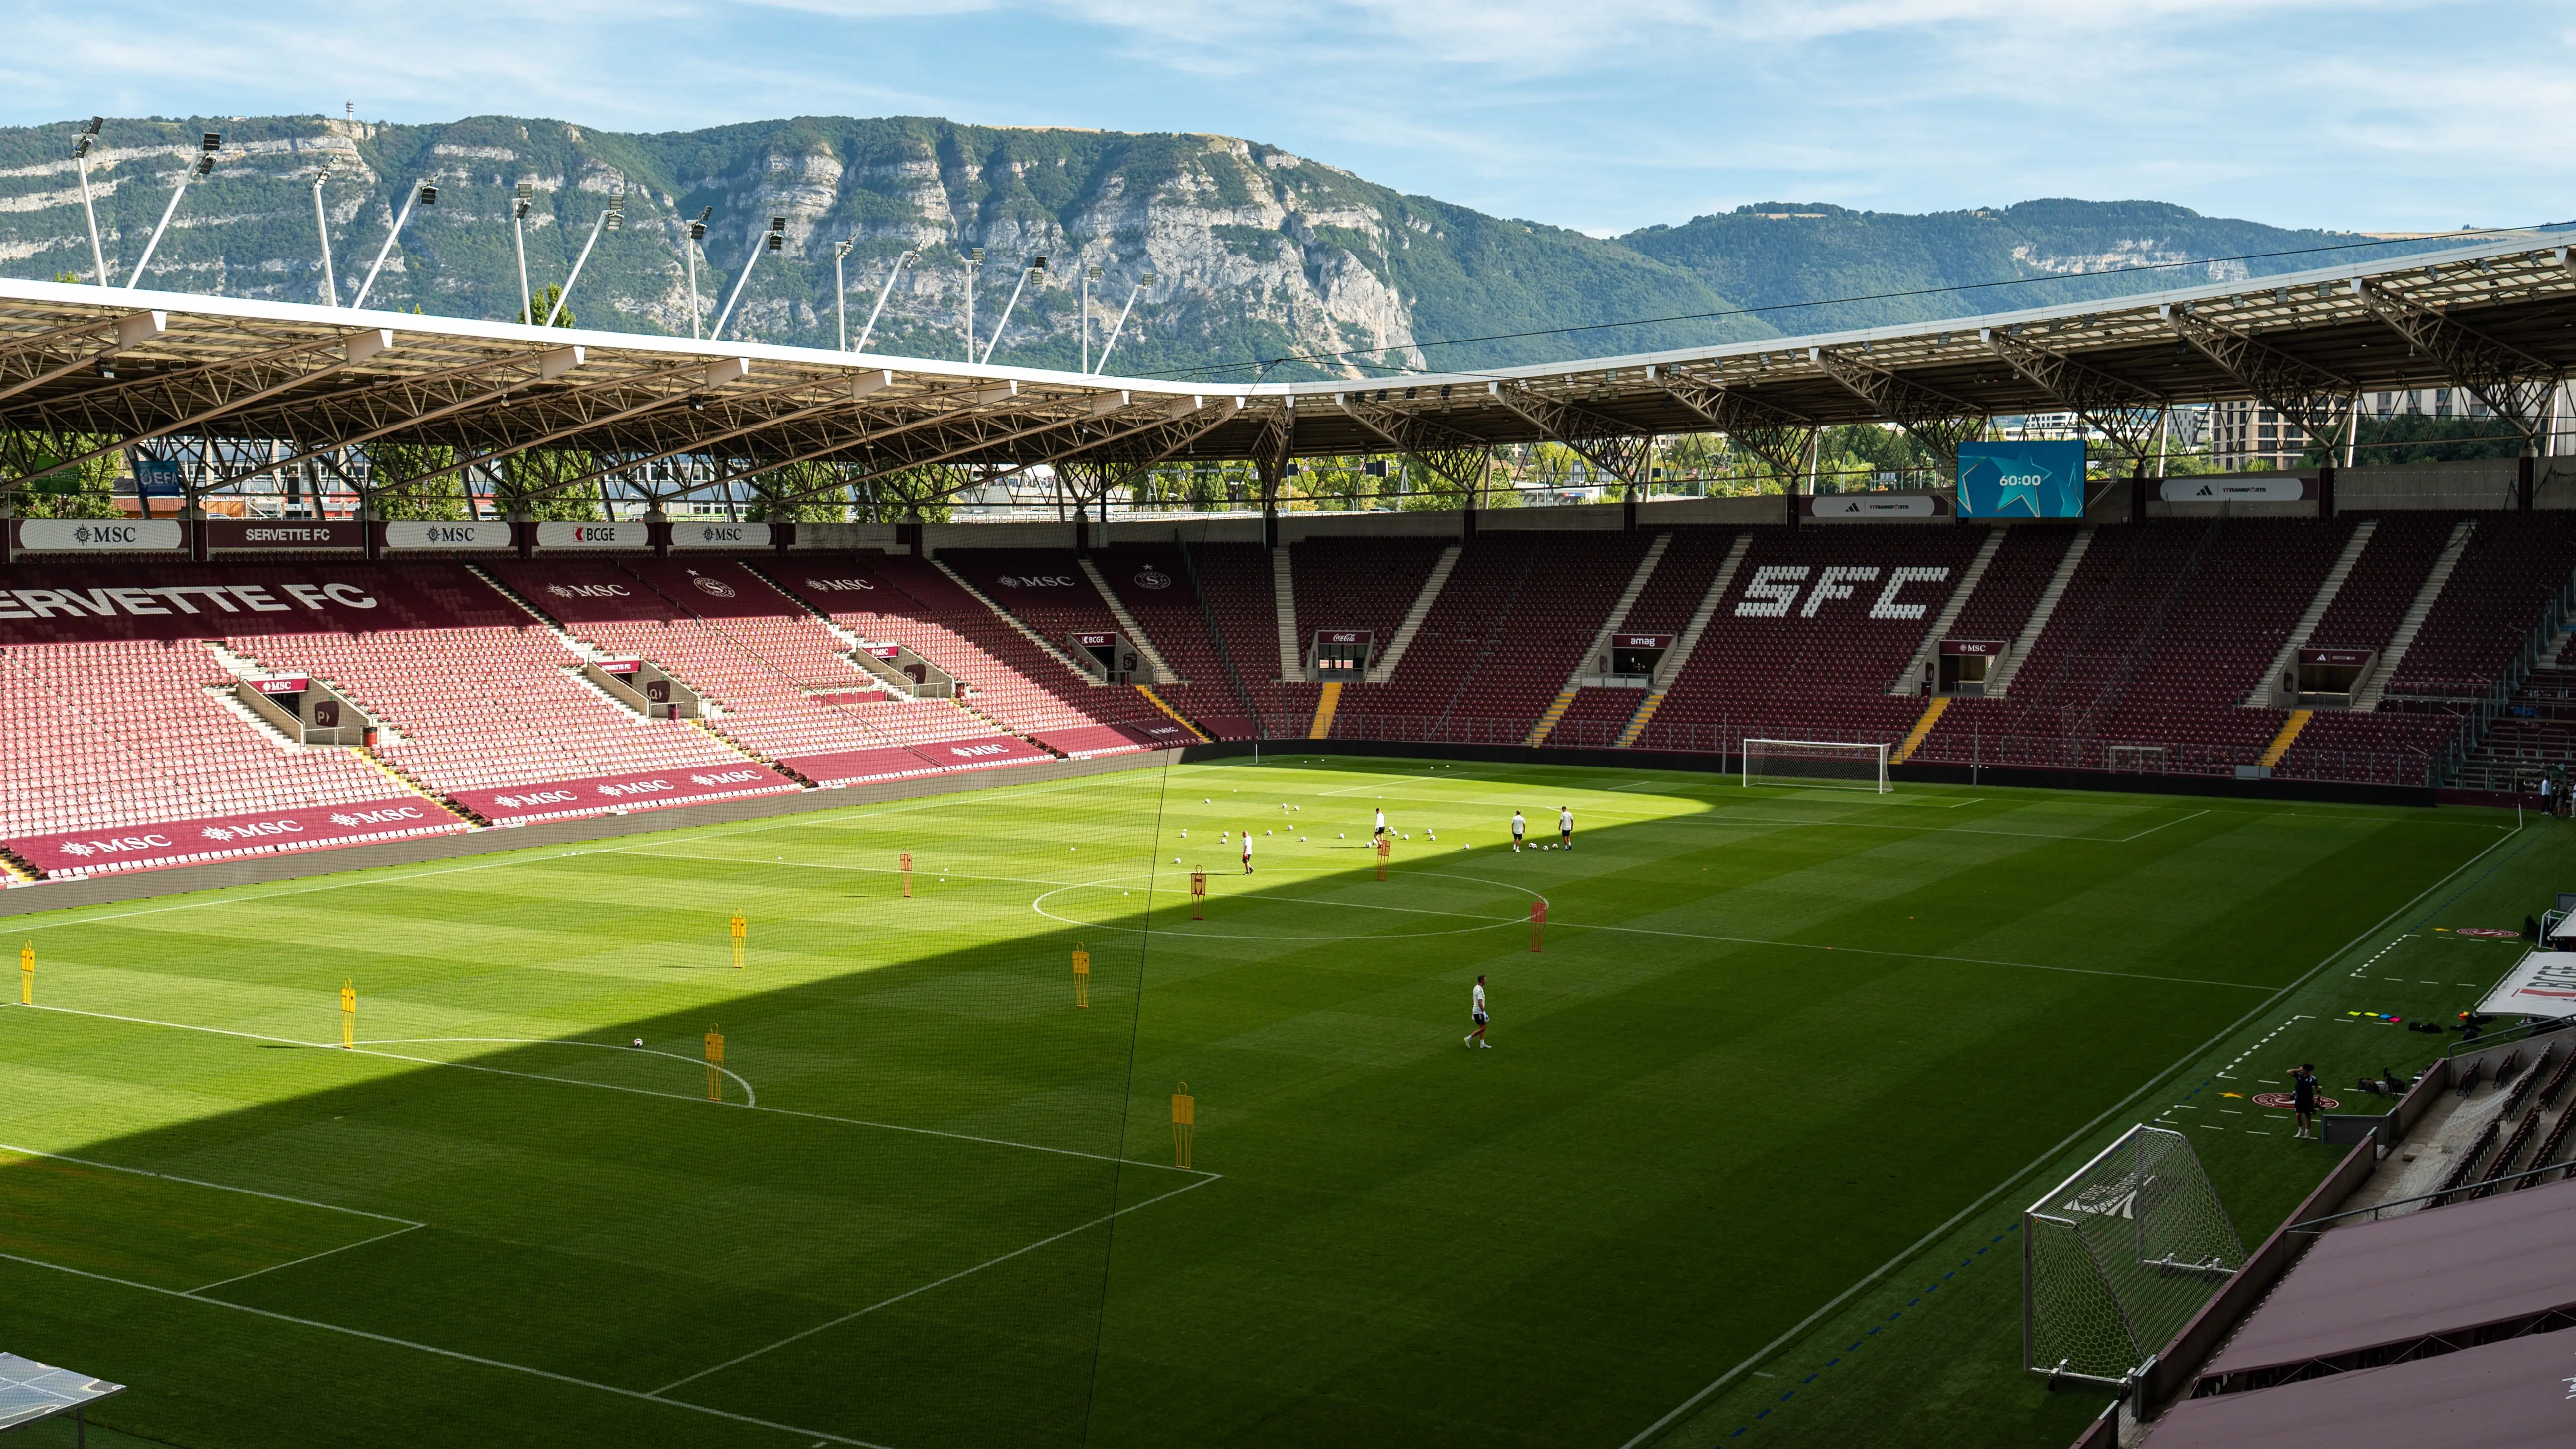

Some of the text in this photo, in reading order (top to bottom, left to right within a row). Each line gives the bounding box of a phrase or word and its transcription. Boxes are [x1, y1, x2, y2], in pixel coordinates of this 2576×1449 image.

[140, 471, 178, 485] UEFA
[1999, 475, 2041, 486] 60:00
[94, 527, 136, 542] MSC
[246, 528, 330, 541] SERVETTE FC
[442, 528, 474, 541] MSC
[586, 528, 615, 541] BCGE
[715, 528, 742, 540] MSC
[825, 579, 874, 590] MSC
[1019, 576, 1075, 587] MSC
[281, 583, 378, 610] FC
[567, 584, 630, 597] MSC
[1735, 566, 1949, 619] SFC
[1631, 638, 1655, 647] amag
[271, 681, 291, 691] MSC
[650, 688, 658, 700] Q
[317, 711, 325, 723] P
[968, 743, 1010, 755] MSC
[712, 769, 763, 784] MSC
[616, 779, 674, 795] MSC
[515, 790, 578, 806] MSC
[354, 807, 424, 823] MSC
[228, 820, 304, 838] MSC
[89, 834, 172, 853] MSC
[2526, 966, 2576, 990] BCGE
